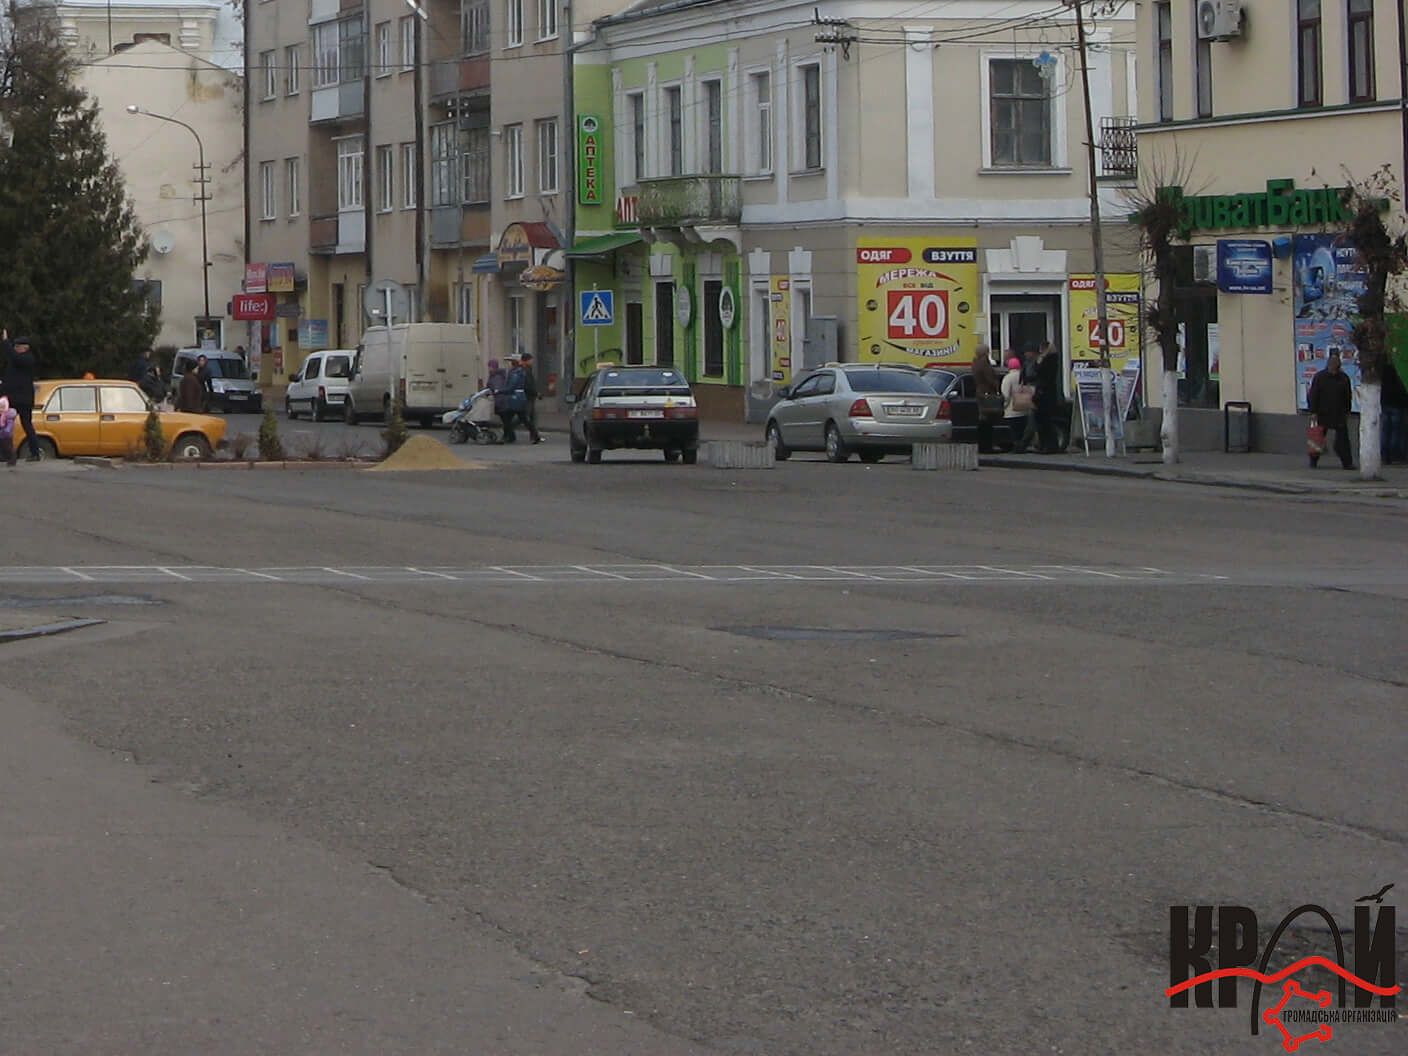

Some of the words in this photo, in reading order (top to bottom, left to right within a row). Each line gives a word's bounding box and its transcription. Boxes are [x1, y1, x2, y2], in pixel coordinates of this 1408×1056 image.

[585, 134, 596, 201] АПТЕКА
[860, 250, 893, 262] ОДЯГ
[931, 250, 974, 261] ВЗУТТЯ
[879, 268, 937, 284] МЕРЕЖА
[240, 299, 268, 314] life:)
[889, 294, 946, 336] 40
